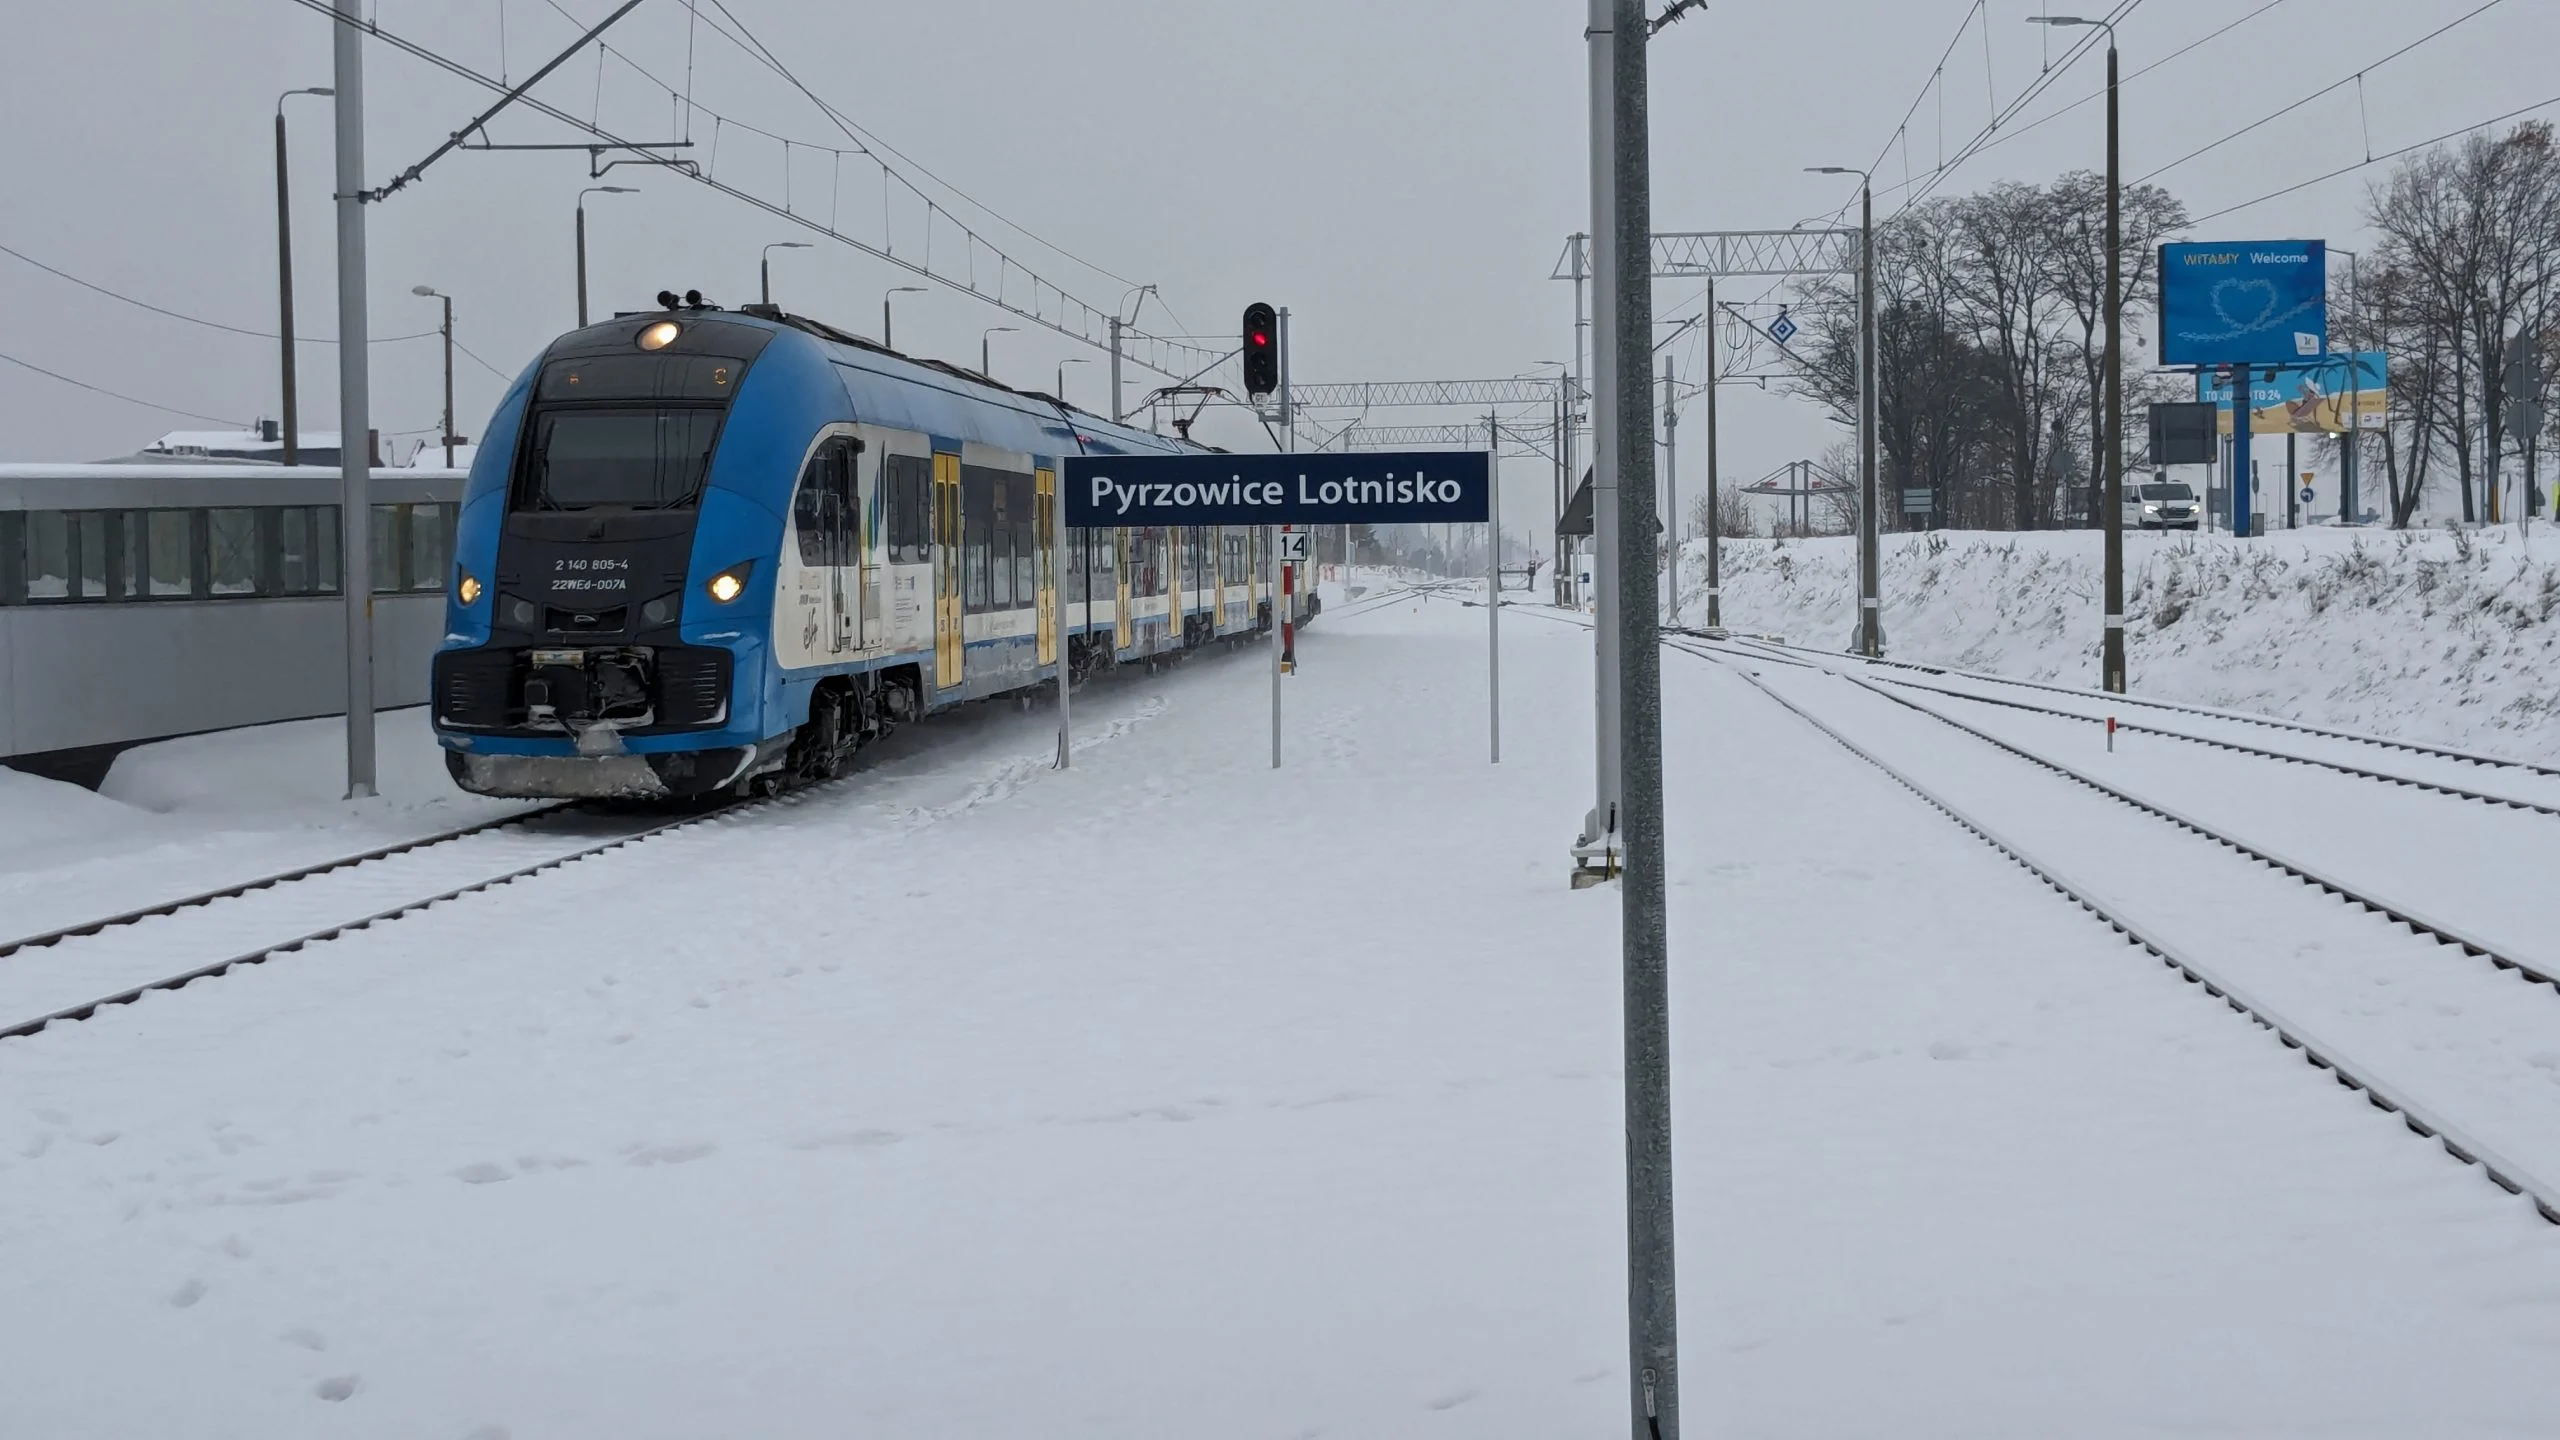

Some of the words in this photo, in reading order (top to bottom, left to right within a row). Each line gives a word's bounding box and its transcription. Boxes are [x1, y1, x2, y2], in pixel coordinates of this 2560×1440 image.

[2184, 253, 2239, 265] WITAMY
[2249, 252, 2308, 264] Welcome
[2267, 389, 2281, 401] 24
[1091, 474, 1284, 514] Pyrzowice
[1299, 471, 1462, 504] Lotnisko
[1281, 535, 1304, 557] 14
[555, 560, 564, 571] 2
[568, 560, 588, 570] 140
